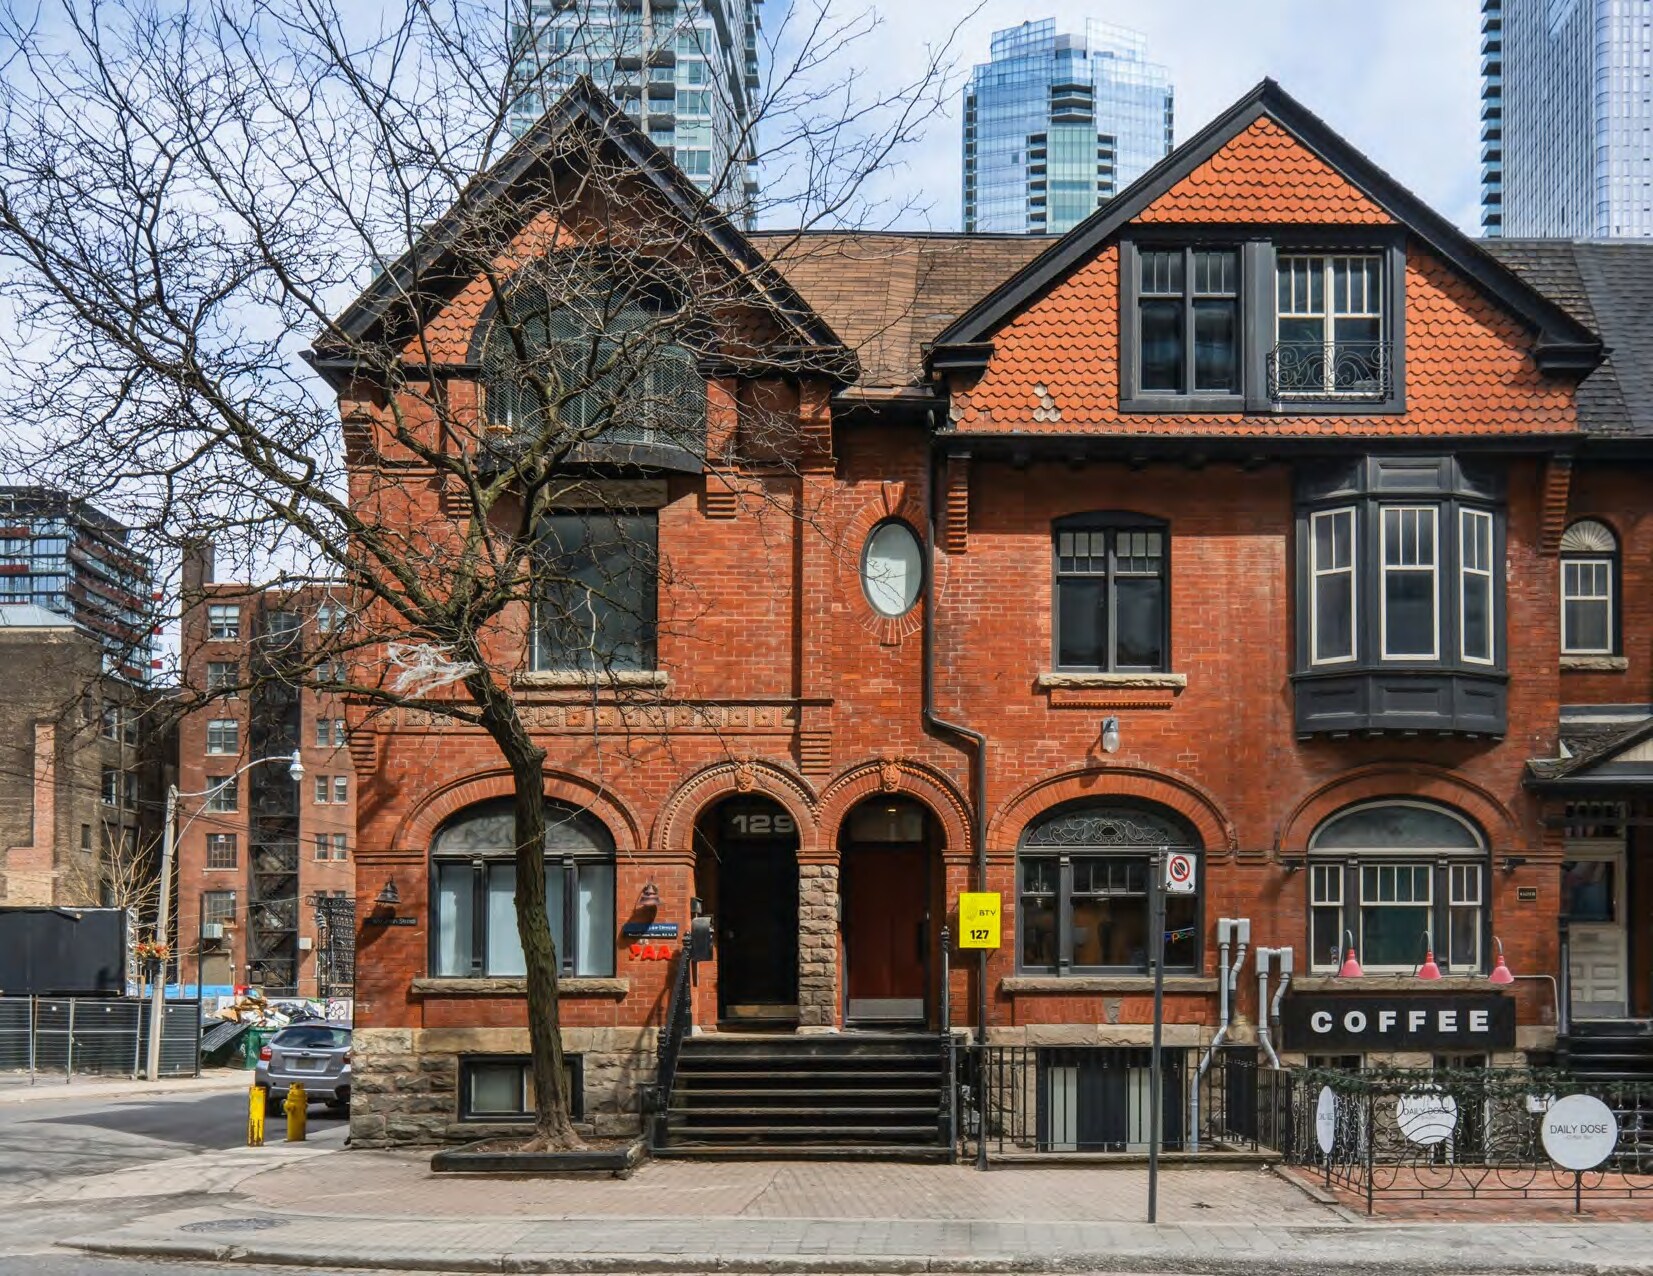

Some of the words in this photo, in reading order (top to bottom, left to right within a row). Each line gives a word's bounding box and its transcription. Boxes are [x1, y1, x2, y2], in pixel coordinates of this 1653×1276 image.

[731, 814, 794, 833] 129
[970, 930, 989, 940] 127
[1310, 1010, 1489, 1033] COFFEE
[1550, 1124, 1578, 1134] DAILY
[1580, 1124, 1608, 1133] DOSE
